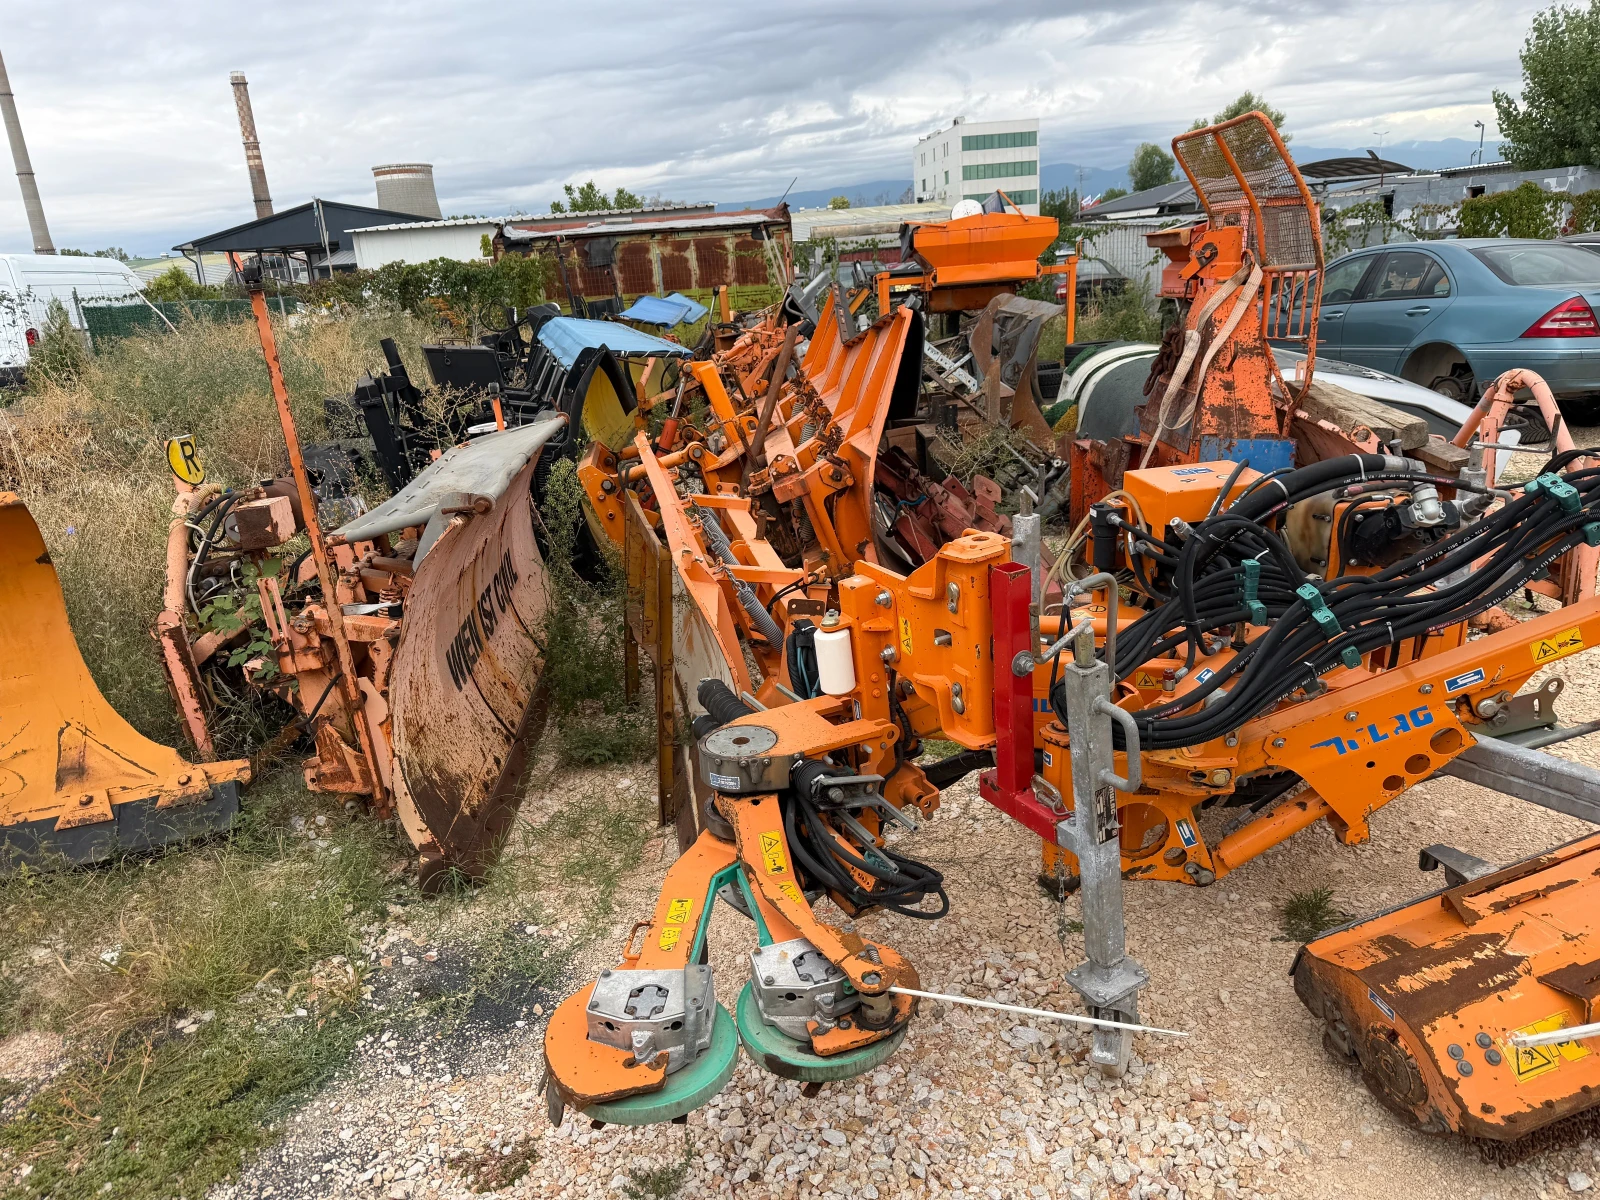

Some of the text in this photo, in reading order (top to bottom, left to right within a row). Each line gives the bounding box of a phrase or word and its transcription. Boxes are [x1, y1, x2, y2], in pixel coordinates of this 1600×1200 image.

[180, 441, 200, 475] R
[446, 547, 519, 693] WIEN IST COOL
